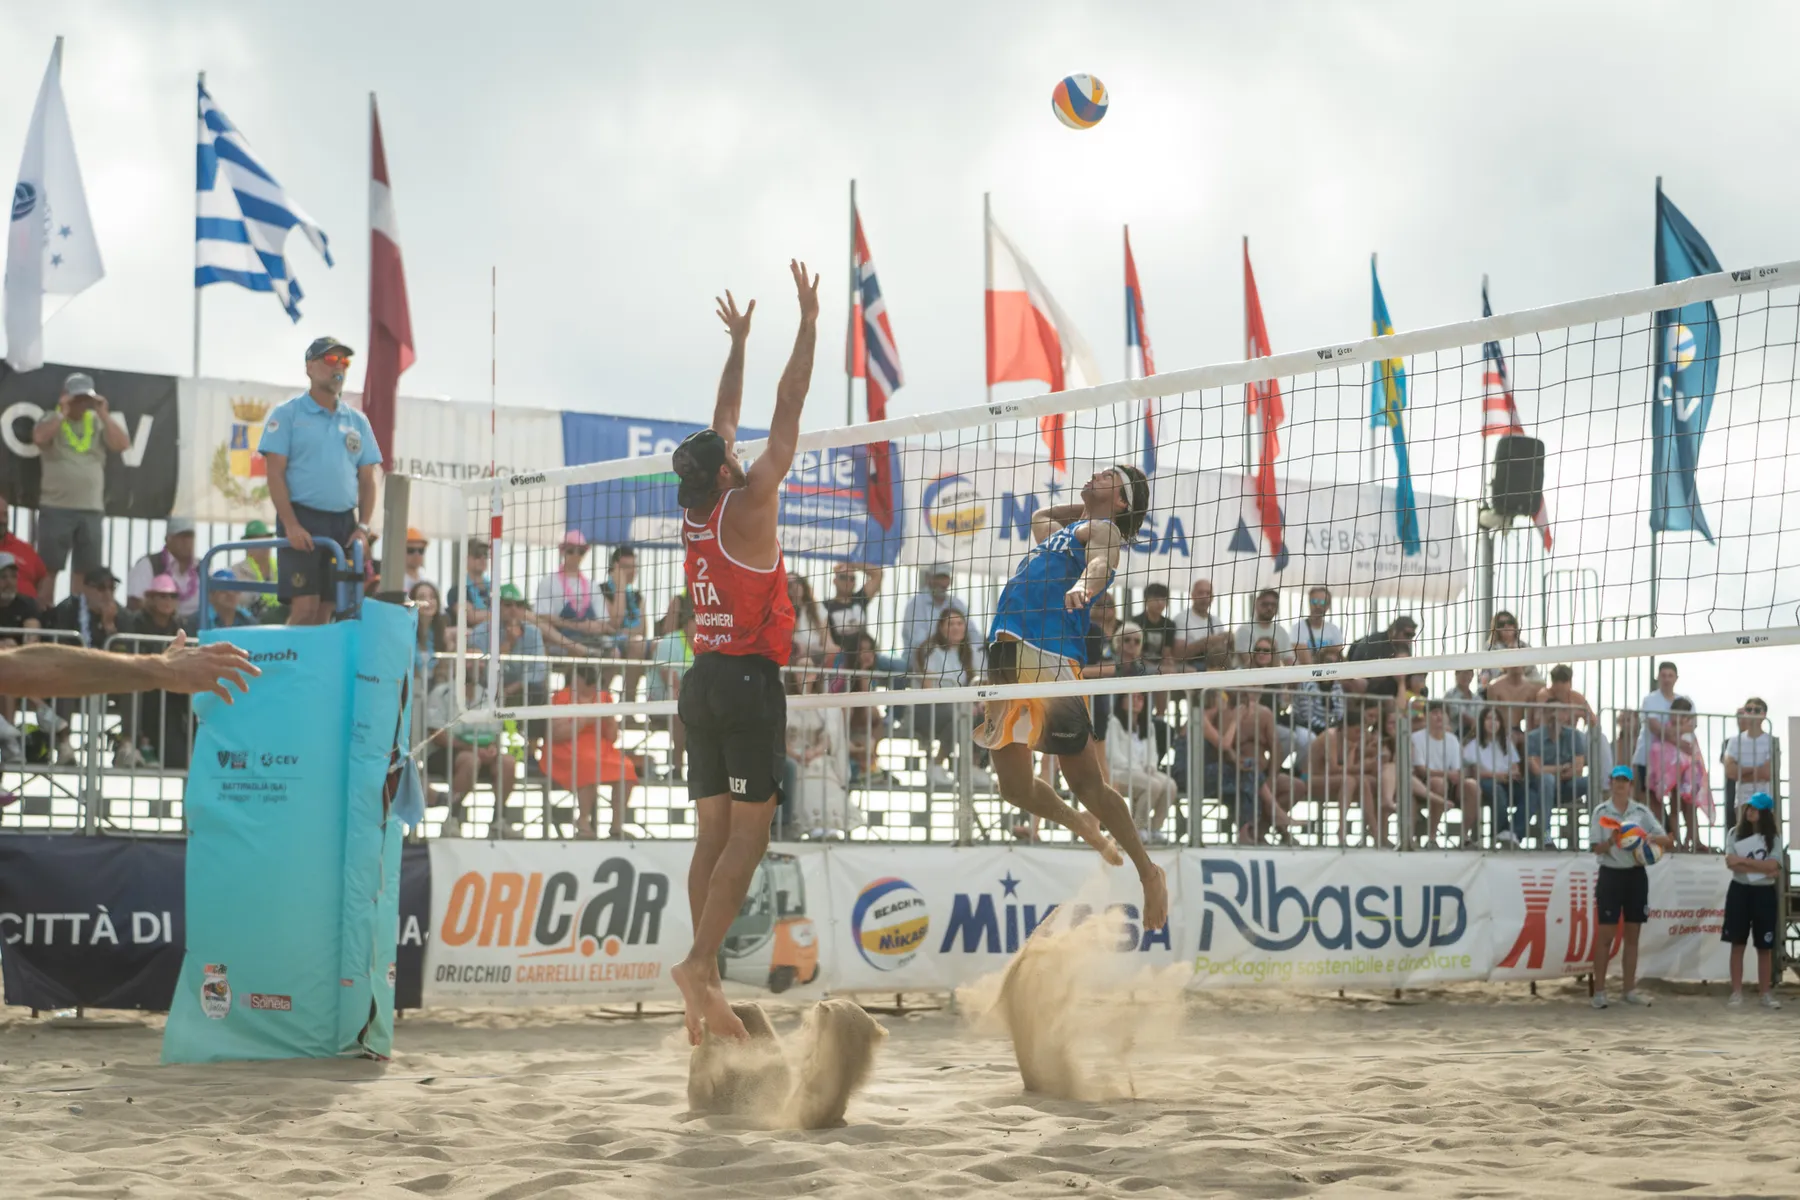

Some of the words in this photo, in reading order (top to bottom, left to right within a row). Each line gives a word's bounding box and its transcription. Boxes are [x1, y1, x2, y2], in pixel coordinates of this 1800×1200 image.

[1658, 376, 1701, 422] CV
[1, 401, 154, 468] CV
[518, 473, 546, 485] Senoh
[1306, 529, 1441, 560] A&BSTUO
[697, 557, 710, 580] 2
[692, 582, 721, 606] ITA
[275, 755, 299, 766] CEV
[874, 898, 912, 919] BEACH
[1663, 909, 1694, 919] nuova
[1, 905, 118, 945] CITTÀ
[133, 910, 173, 944] DI
[435, 964, 512, 984] ORICCHIO
[515, 964, 585, 984] CARRELLI
[588, 962, 662, 982] ELEVATORI
[1194, 957, 1293, 982] Packaging
[1297, 955, 1382, 976] sostenibile
[1386, 959, 1395, 973] e
[1398, 950, 1472, 971] circolare
